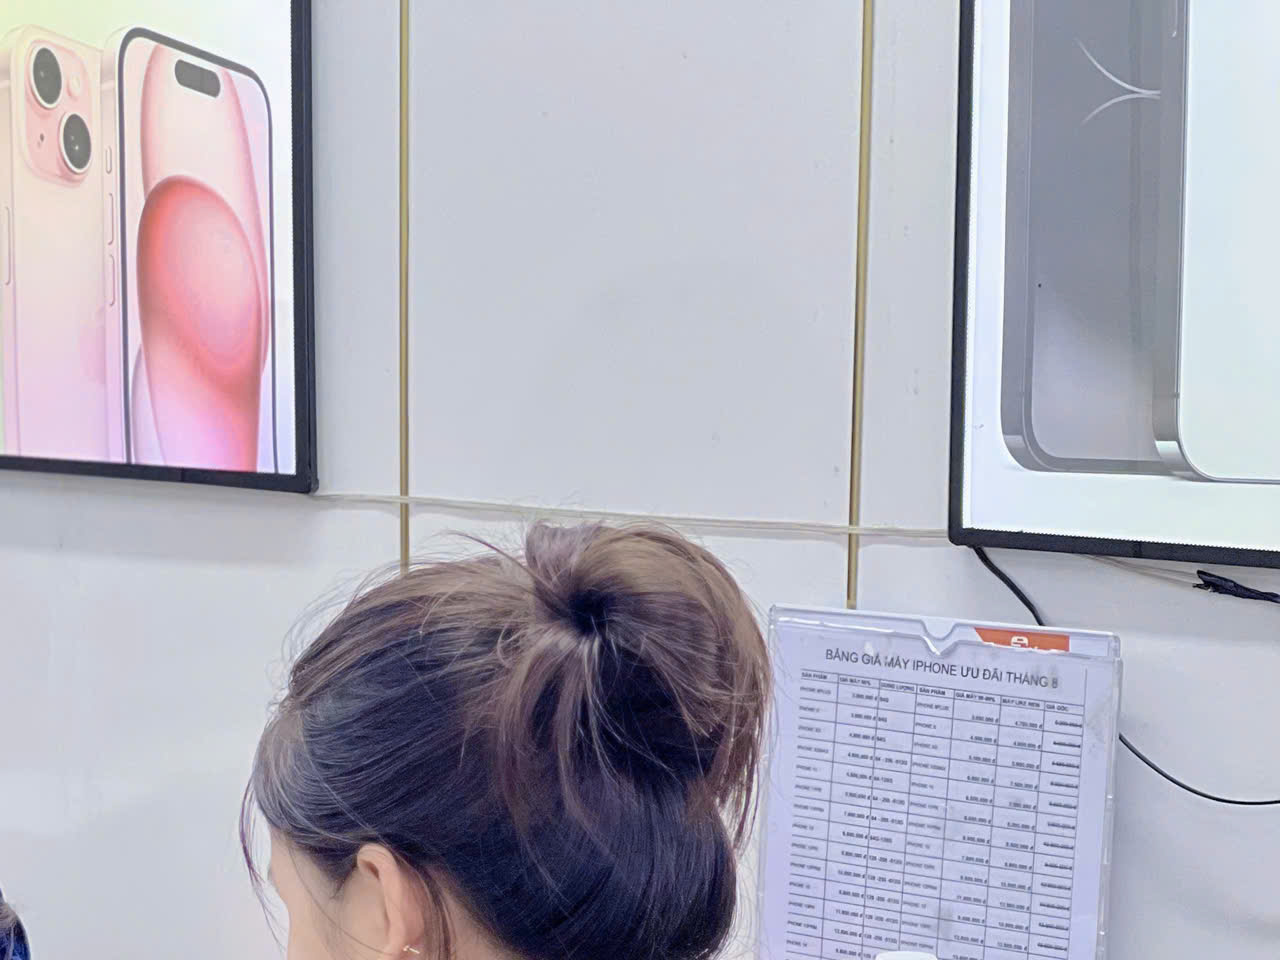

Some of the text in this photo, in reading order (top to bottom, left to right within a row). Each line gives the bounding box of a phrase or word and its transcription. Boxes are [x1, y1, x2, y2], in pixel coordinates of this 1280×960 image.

[912, 660, 957, 676] IPHONE
[961, 666, 979, 679] ƯU
[982, 667, 1002, 681] ĐÃI
[1006, 670, 1048, 687] THÁNG
